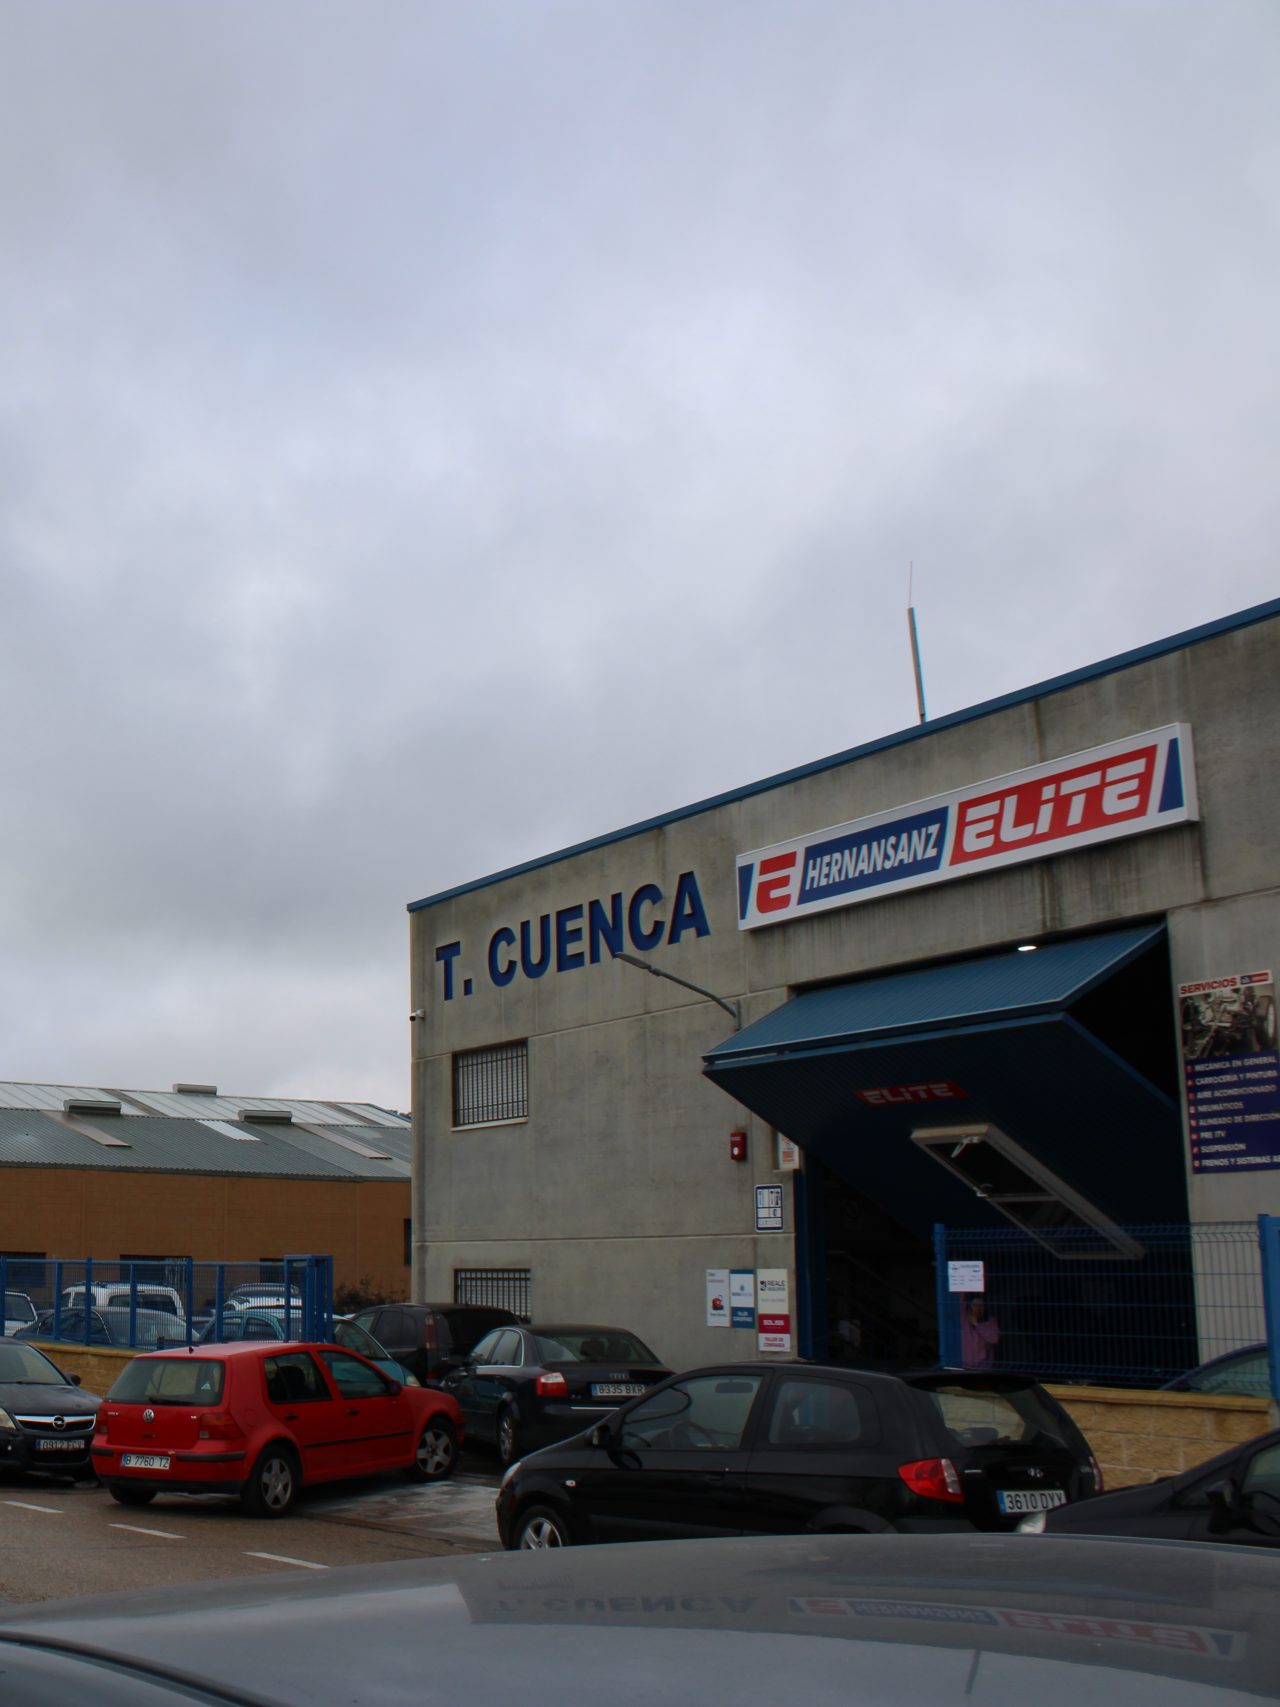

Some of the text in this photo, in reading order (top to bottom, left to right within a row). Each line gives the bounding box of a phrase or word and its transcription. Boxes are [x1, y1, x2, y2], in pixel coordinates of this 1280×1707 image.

[805, 823, 941, 890] HERNANSANZ
[435, 870, 711, 1001] T. CUENCA
[1180, 977, 1238, 994] SERVICIOS
[1243, 1056, 1277, 1066] GENERAL
[1245, 1070, 1278, 1080] PINTURA
[125, 1455, 169, 1468] B 7760 TZ
[1006, 1493, 1037, 1510] 3610
